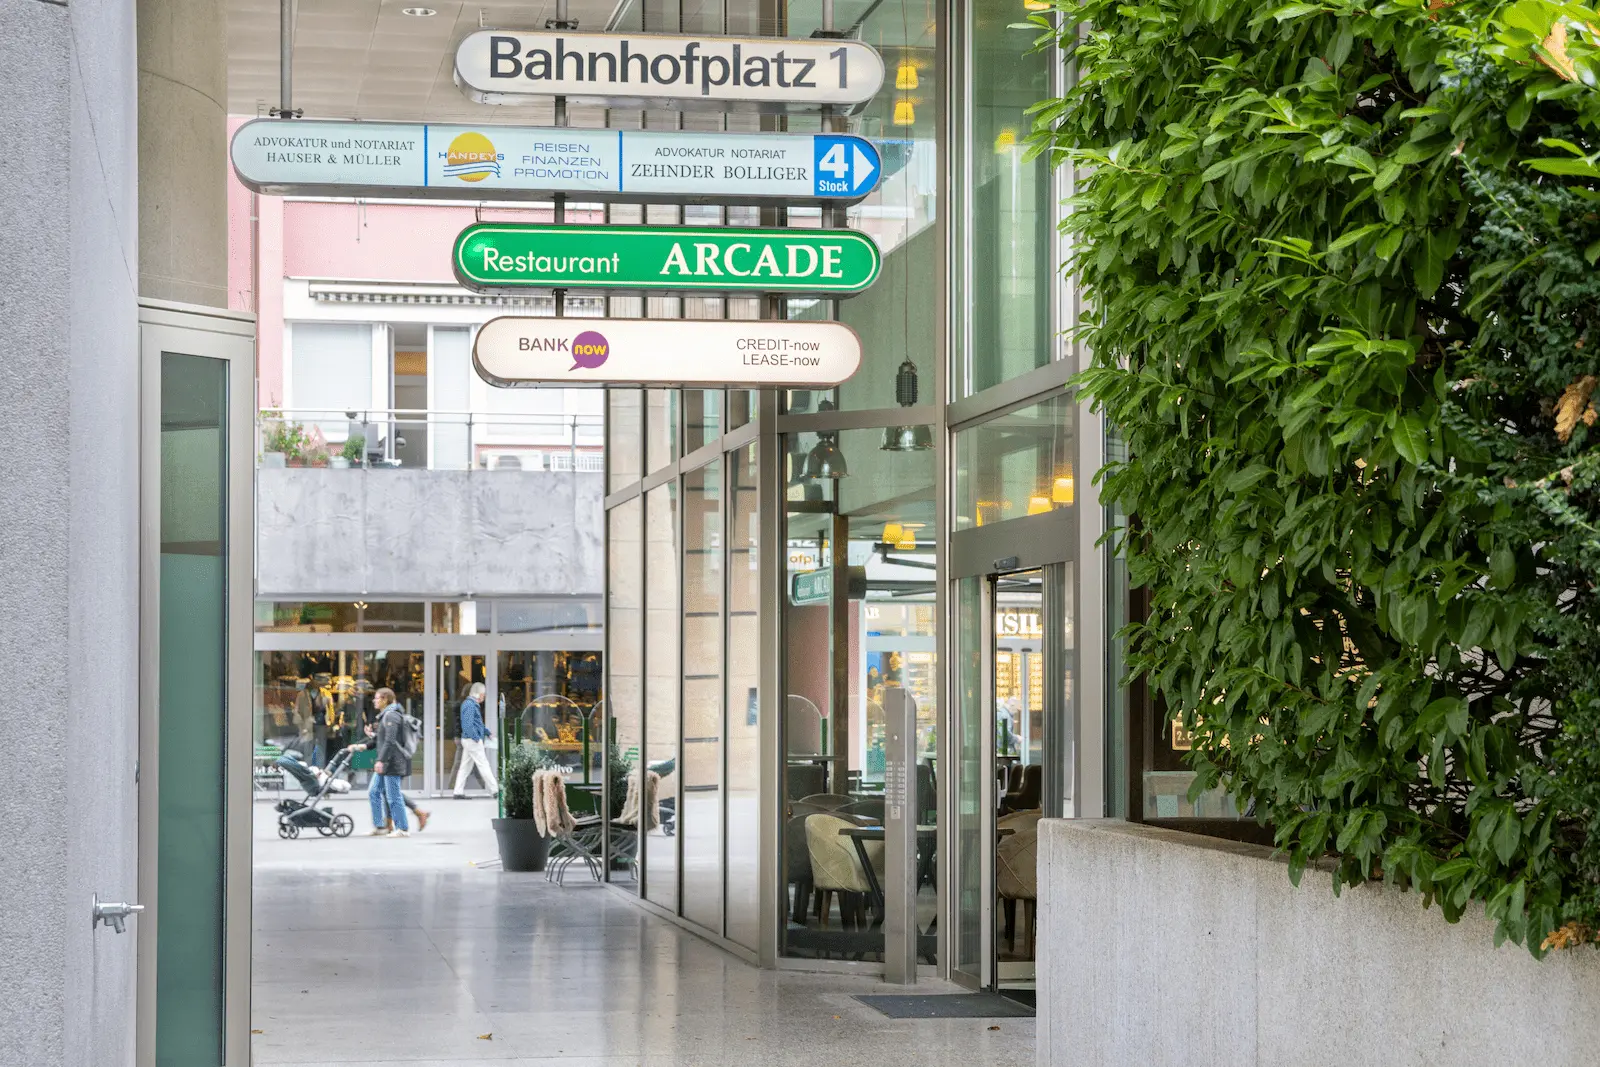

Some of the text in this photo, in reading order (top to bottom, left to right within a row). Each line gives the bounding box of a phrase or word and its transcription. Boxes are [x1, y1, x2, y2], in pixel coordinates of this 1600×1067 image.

[490, 36, 848, 95] Bahnhofplatz 1
[254, 137, 415, 151] ADVOKATUR und NOTARIAT
[534, 143, 590, 153] REISEN
[267, 152, 402, 166] HAUSER & MÜLLER
[438, 151, 505, 161] HANDEYS
[655, 147, 786, 159] ADVOKATUR NOTARIAT
[522, 156, 601, 166] FINANZEN
[819, 143, 848, 178] 4
[514, 169, 609, 180] PROMOTION
[631, 164, 808, 181] ZEHNDER BOLLIGER
[819, 179, 848, 192] Stock
[483, 242, 843, 278] Restaurant ARCADE
[519, 337, 607, 355] BANK now
[736, 338, 820, 351] CREDIT-now
[743, 354, 820, 366] LEASE-now
